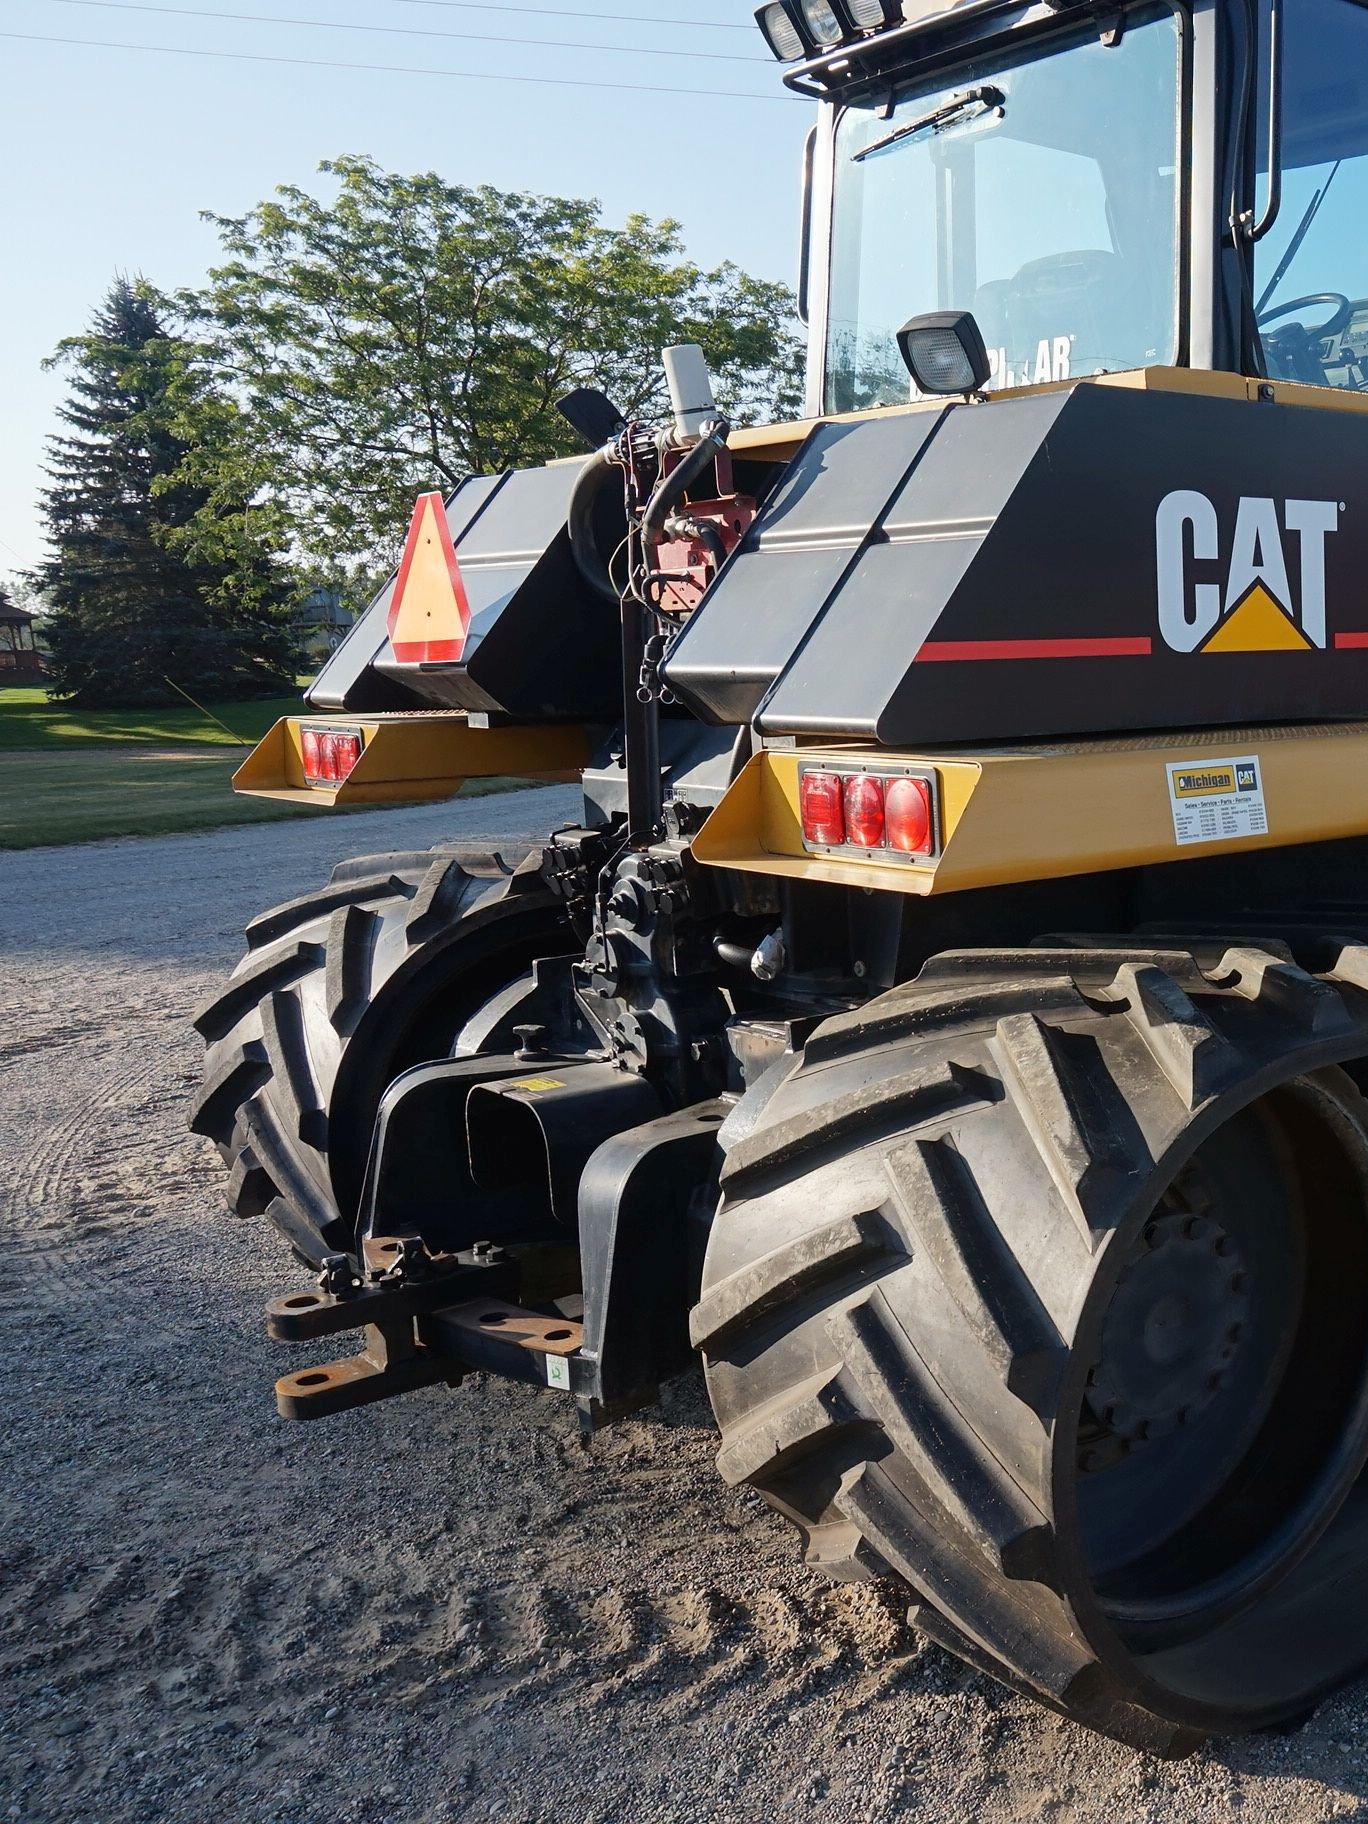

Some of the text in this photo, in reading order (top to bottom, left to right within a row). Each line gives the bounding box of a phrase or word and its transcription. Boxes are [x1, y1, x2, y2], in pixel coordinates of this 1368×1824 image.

[1156, 490, 1338, 653] CAT
[1179, 770, 1254, 789] Michigan CAT
